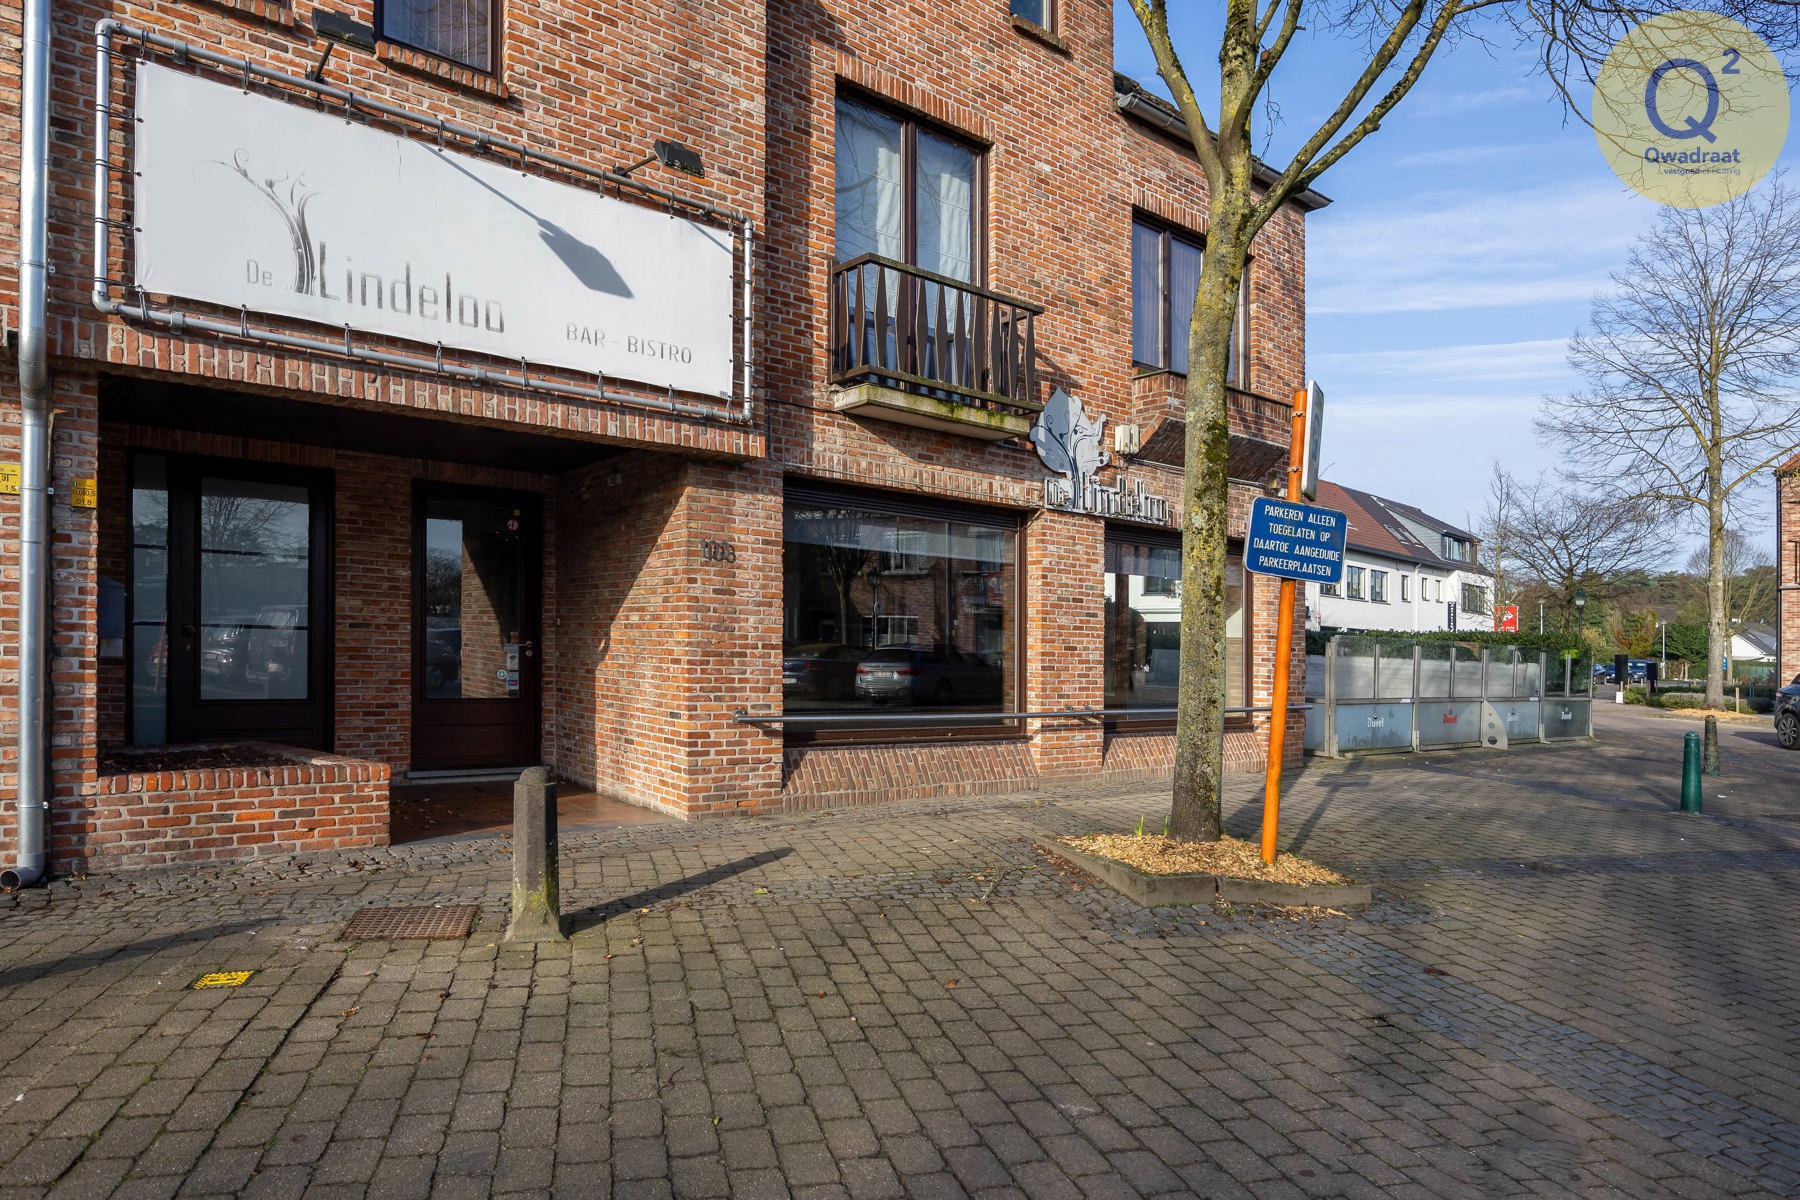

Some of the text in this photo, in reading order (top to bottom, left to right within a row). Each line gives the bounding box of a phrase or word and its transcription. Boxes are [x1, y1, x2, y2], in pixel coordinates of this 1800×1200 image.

[246, 240, 505, 334] De Lindeloo
[566, 321, 606, 348] BAR
[626, 335, 692, 364] BISTRO
[1264, 504, 1336, 528] PARKEREN ALLEEN
[1268, 522, 1331, 543] TOEGELATEN OP
[1253, 537, 1341, 562] DAARTOE AANGEDUIDE
[1258, 555, 1332, 577] PARKEERPLAATSEN
[1367, 717, 1384, 728] Duvel
